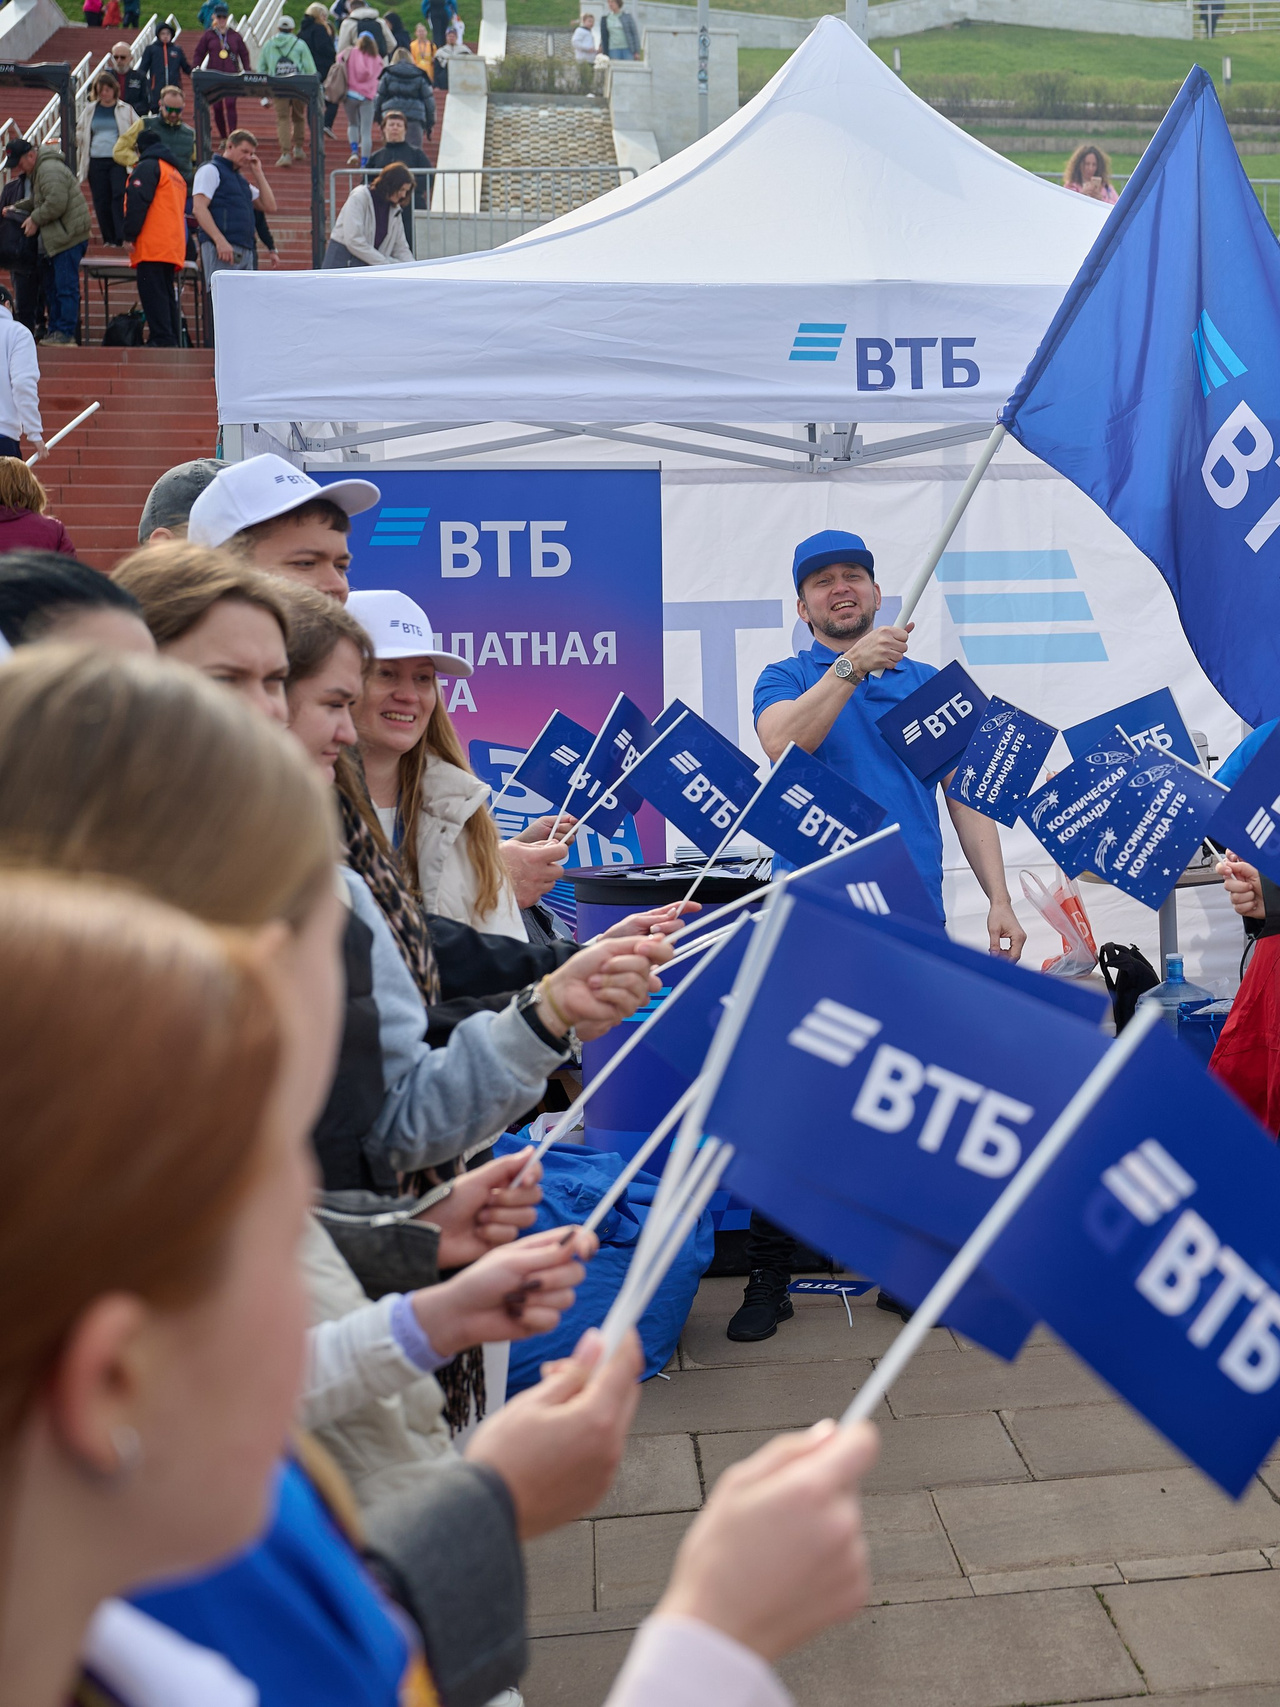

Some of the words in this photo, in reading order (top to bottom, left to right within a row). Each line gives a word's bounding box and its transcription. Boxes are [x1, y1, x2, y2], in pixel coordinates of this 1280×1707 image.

[856, 337, 980, 391] ВТБ
[440, 521, 572, 578] ВТБ
[922, 692, 973, 739] ВТБ
[1129, 723, 1174, 750] ТБ
[975, 723, 1017, 799] КОСМИЧЕСКАЯ
[986, 753, 1017, 804] КОМАНДА
[1012, 732, 1026, 754] ВТБ
[681, 773, 740, 829] ВТБ
[1046, 766, 1128, 833] КОСМИЧЕСКАЯ
[1056, 798, 1111, 844] КОМАНДА
[1112, 779, 1175, 871] КОСМИЧЕСКАЯ
[797, 804, 858, 854] ВТБ
[1126, 817, 1173, 879] КОМАНДА
[1167, 791, 1187, 819] ВТБ
[851, 1043, 1036, 1179] ВТБ
